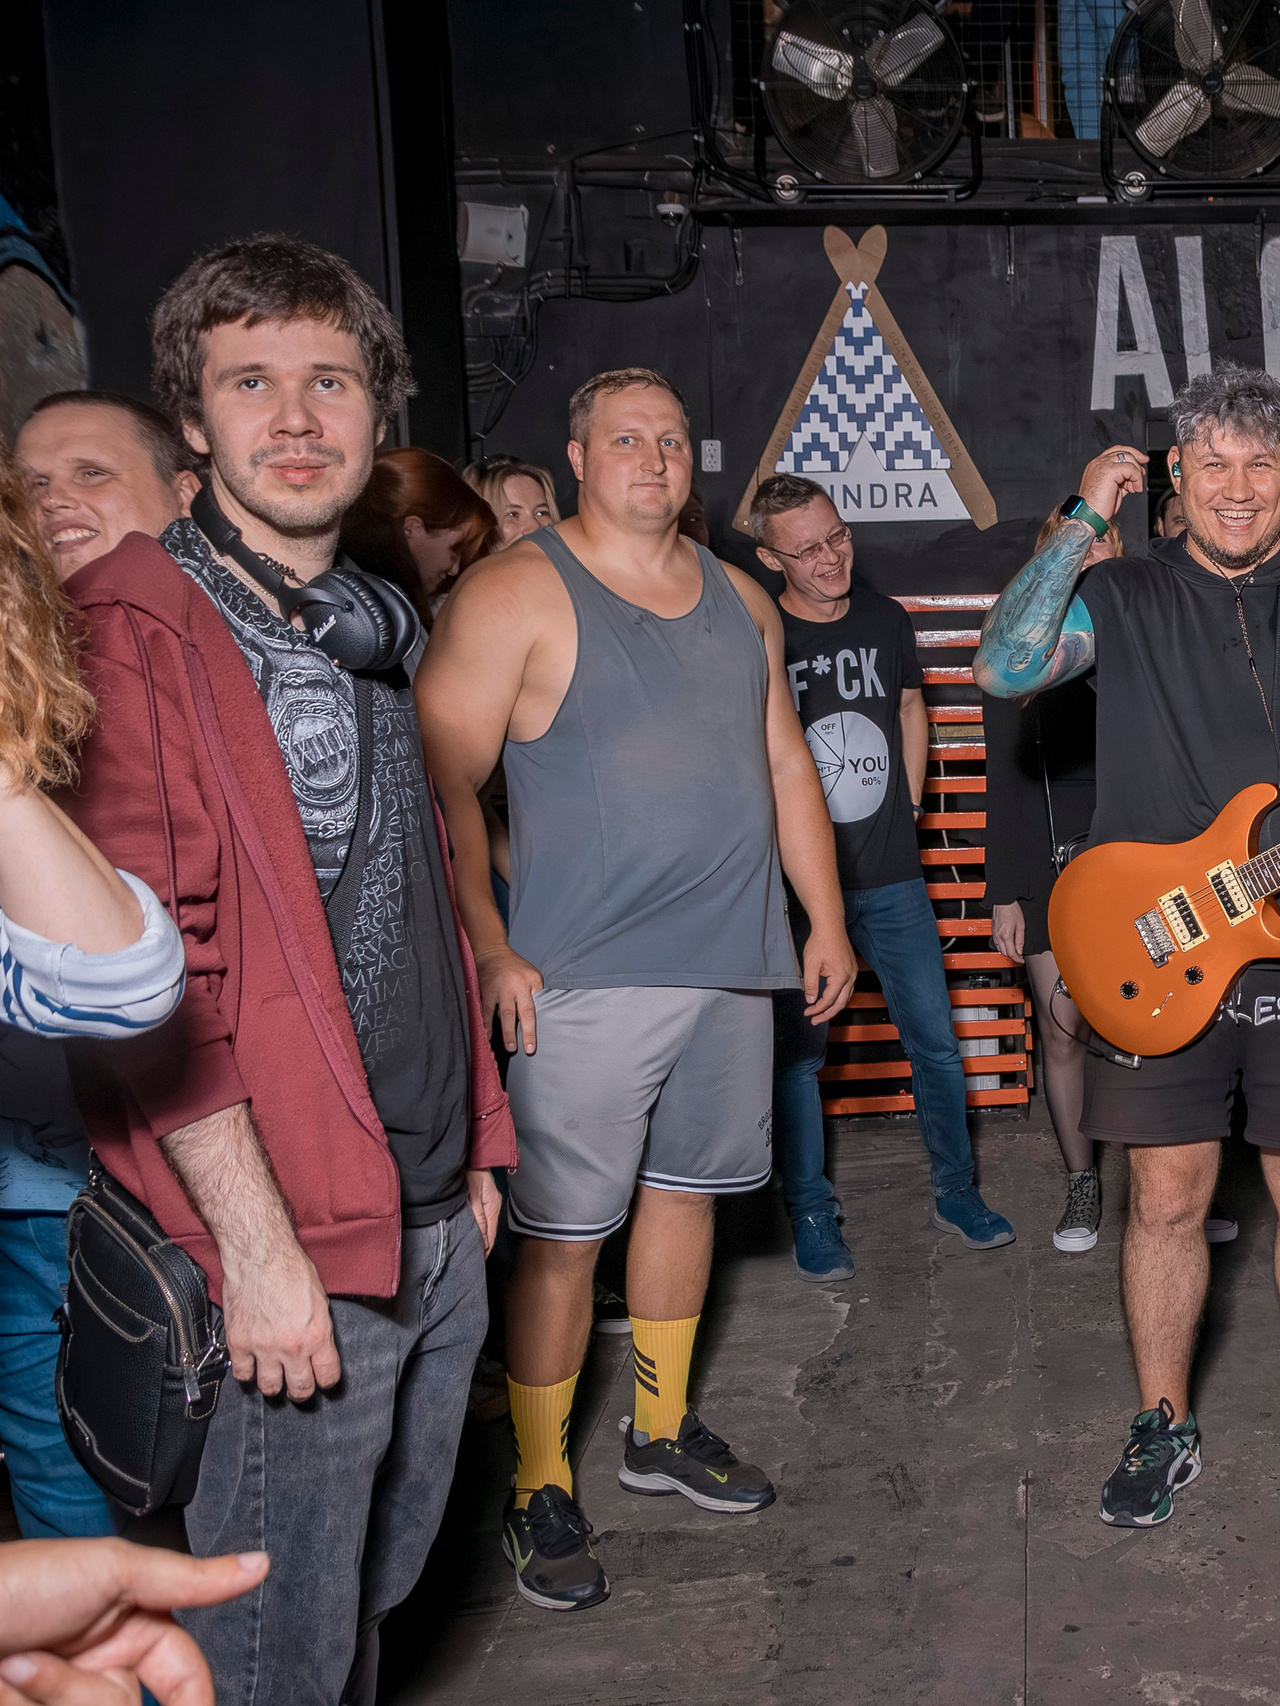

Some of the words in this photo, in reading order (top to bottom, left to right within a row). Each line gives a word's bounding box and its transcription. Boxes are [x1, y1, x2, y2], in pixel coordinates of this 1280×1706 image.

[829, 482, 938, 510] NDRA
[821, 723, 836, 731] OFF
[292, 724, 348, 772] XIII
[848, 756, 887, 774] YOU
[862, 776, 882, 786] 60%
